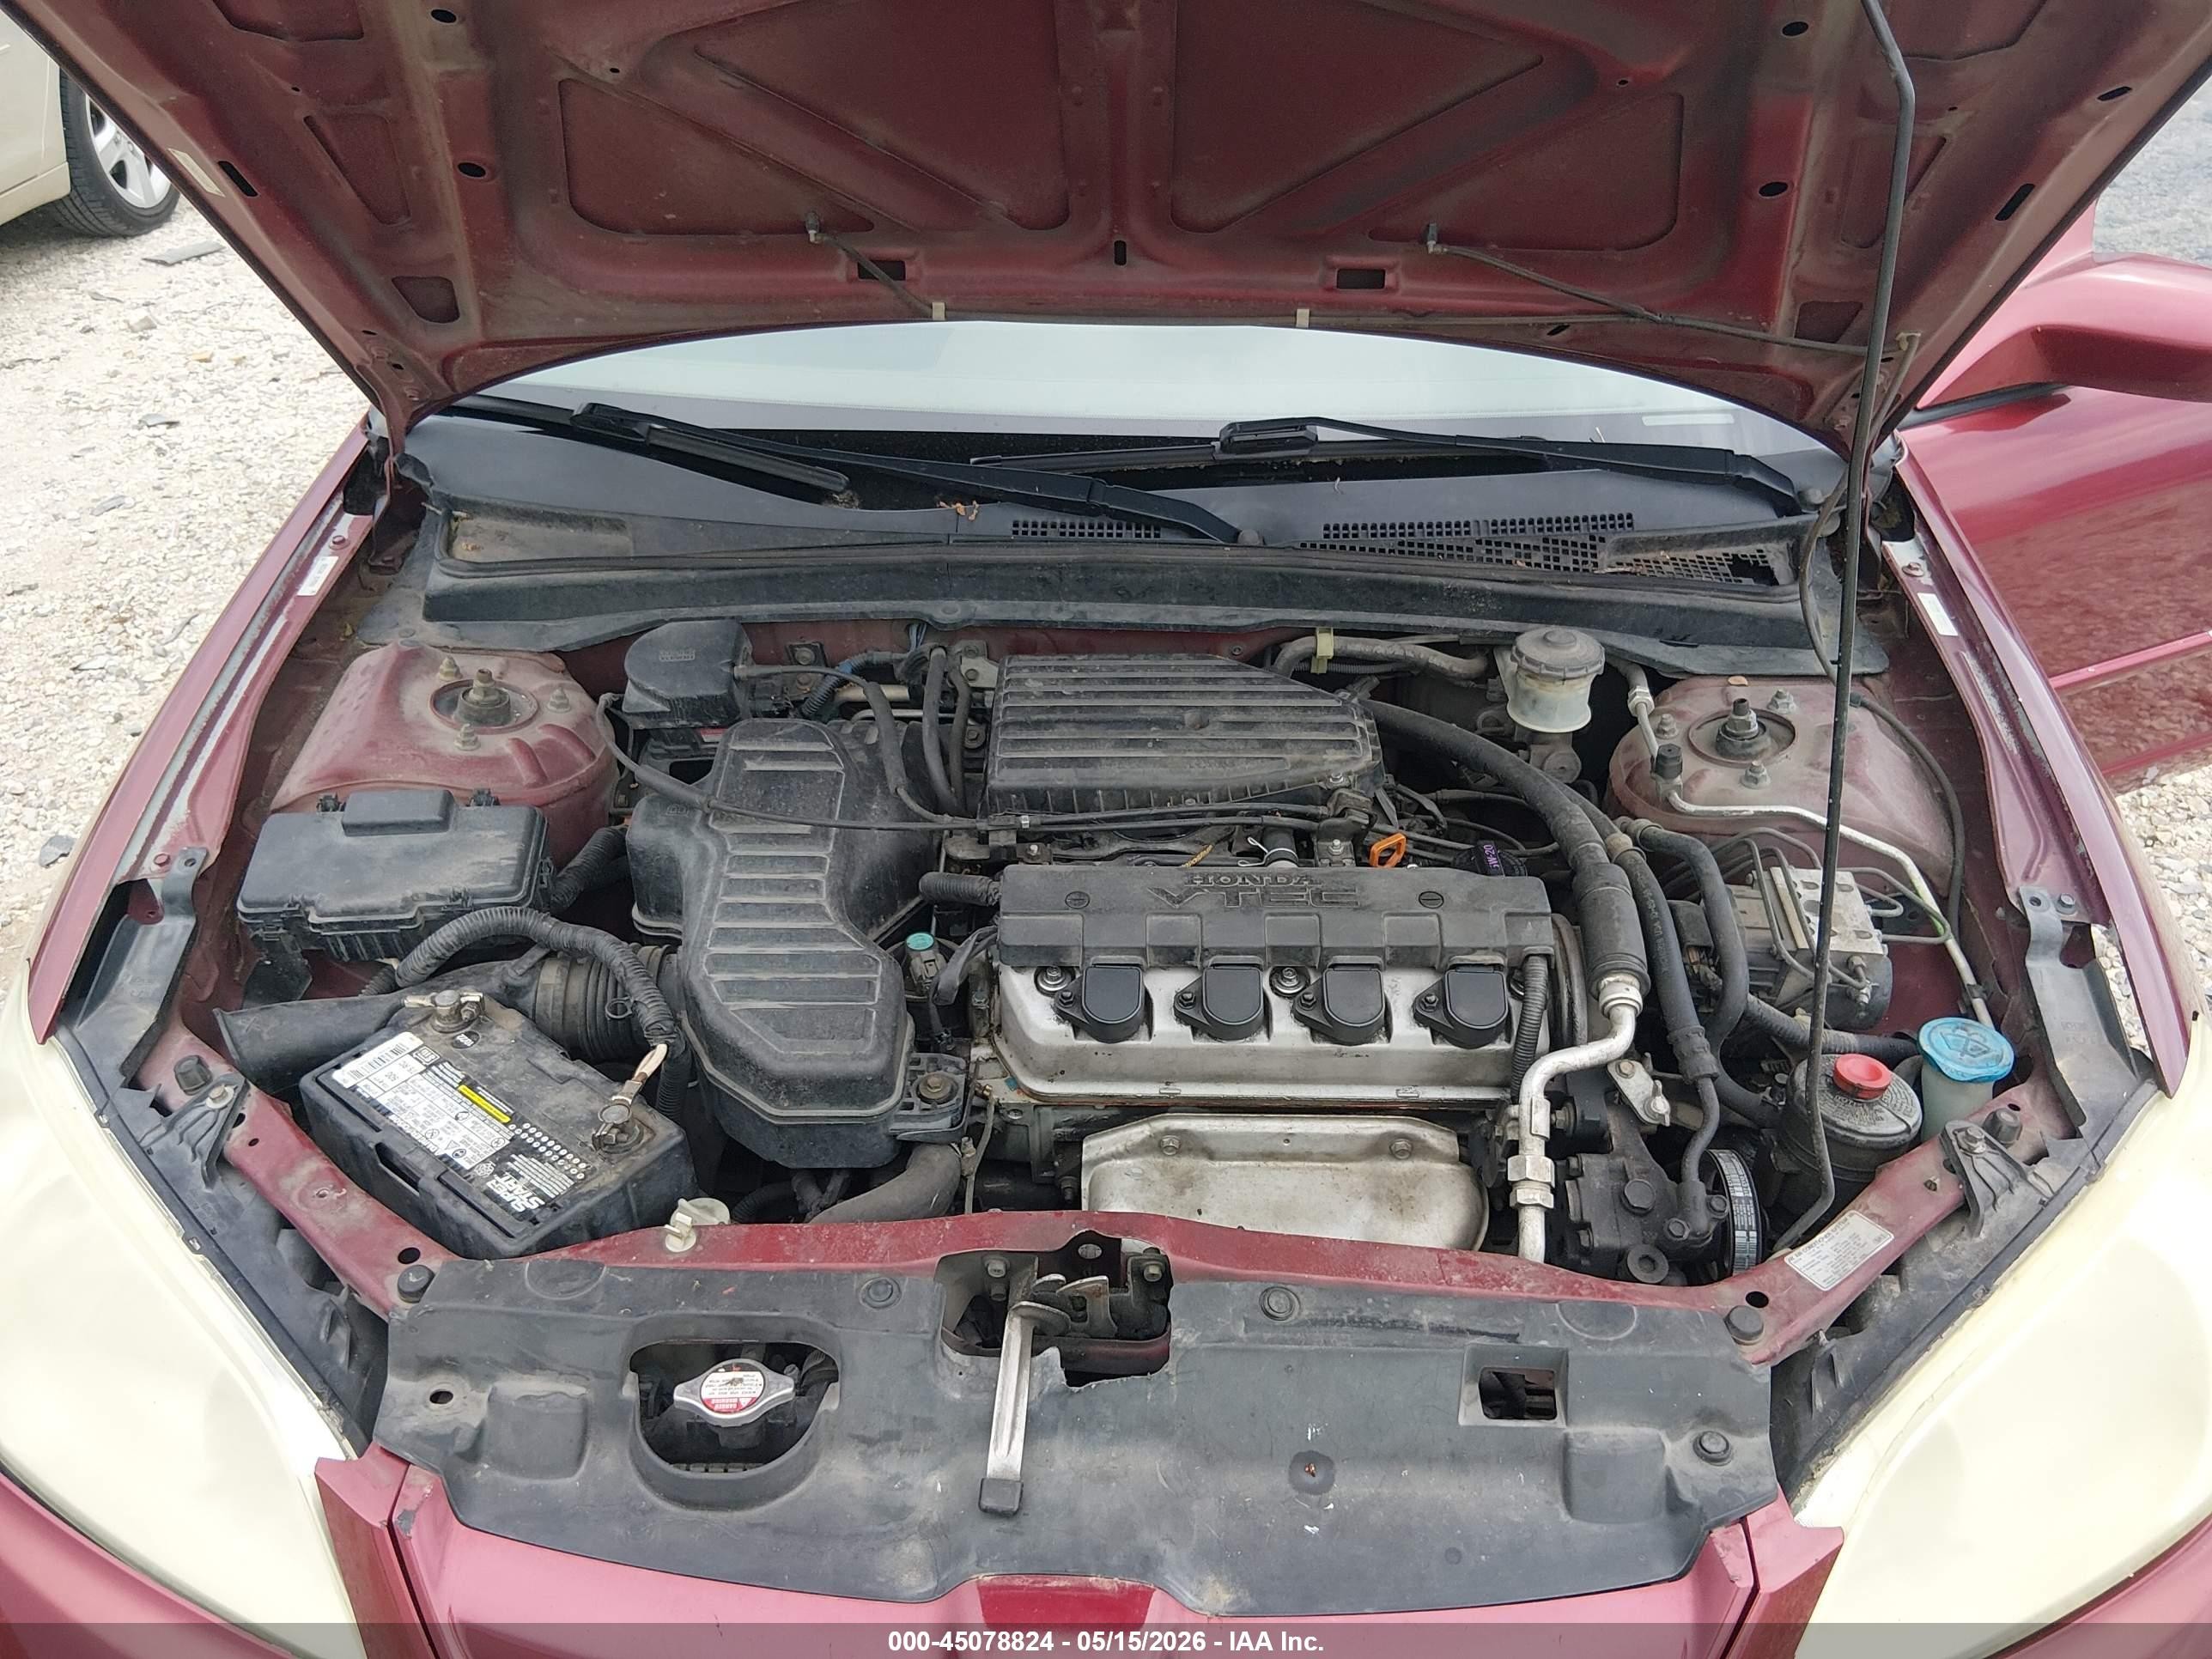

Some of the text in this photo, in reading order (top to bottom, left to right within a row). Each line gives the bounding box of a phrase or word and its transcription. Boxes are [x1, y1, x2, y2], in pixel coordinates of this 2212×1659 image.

[1184, 872, 1323, 887] HONDA
[1147, 886, 1360, 908] VTEC
[486, 1179, 526, 1212] SUPER
[494, 1173, 546, 1209] START
